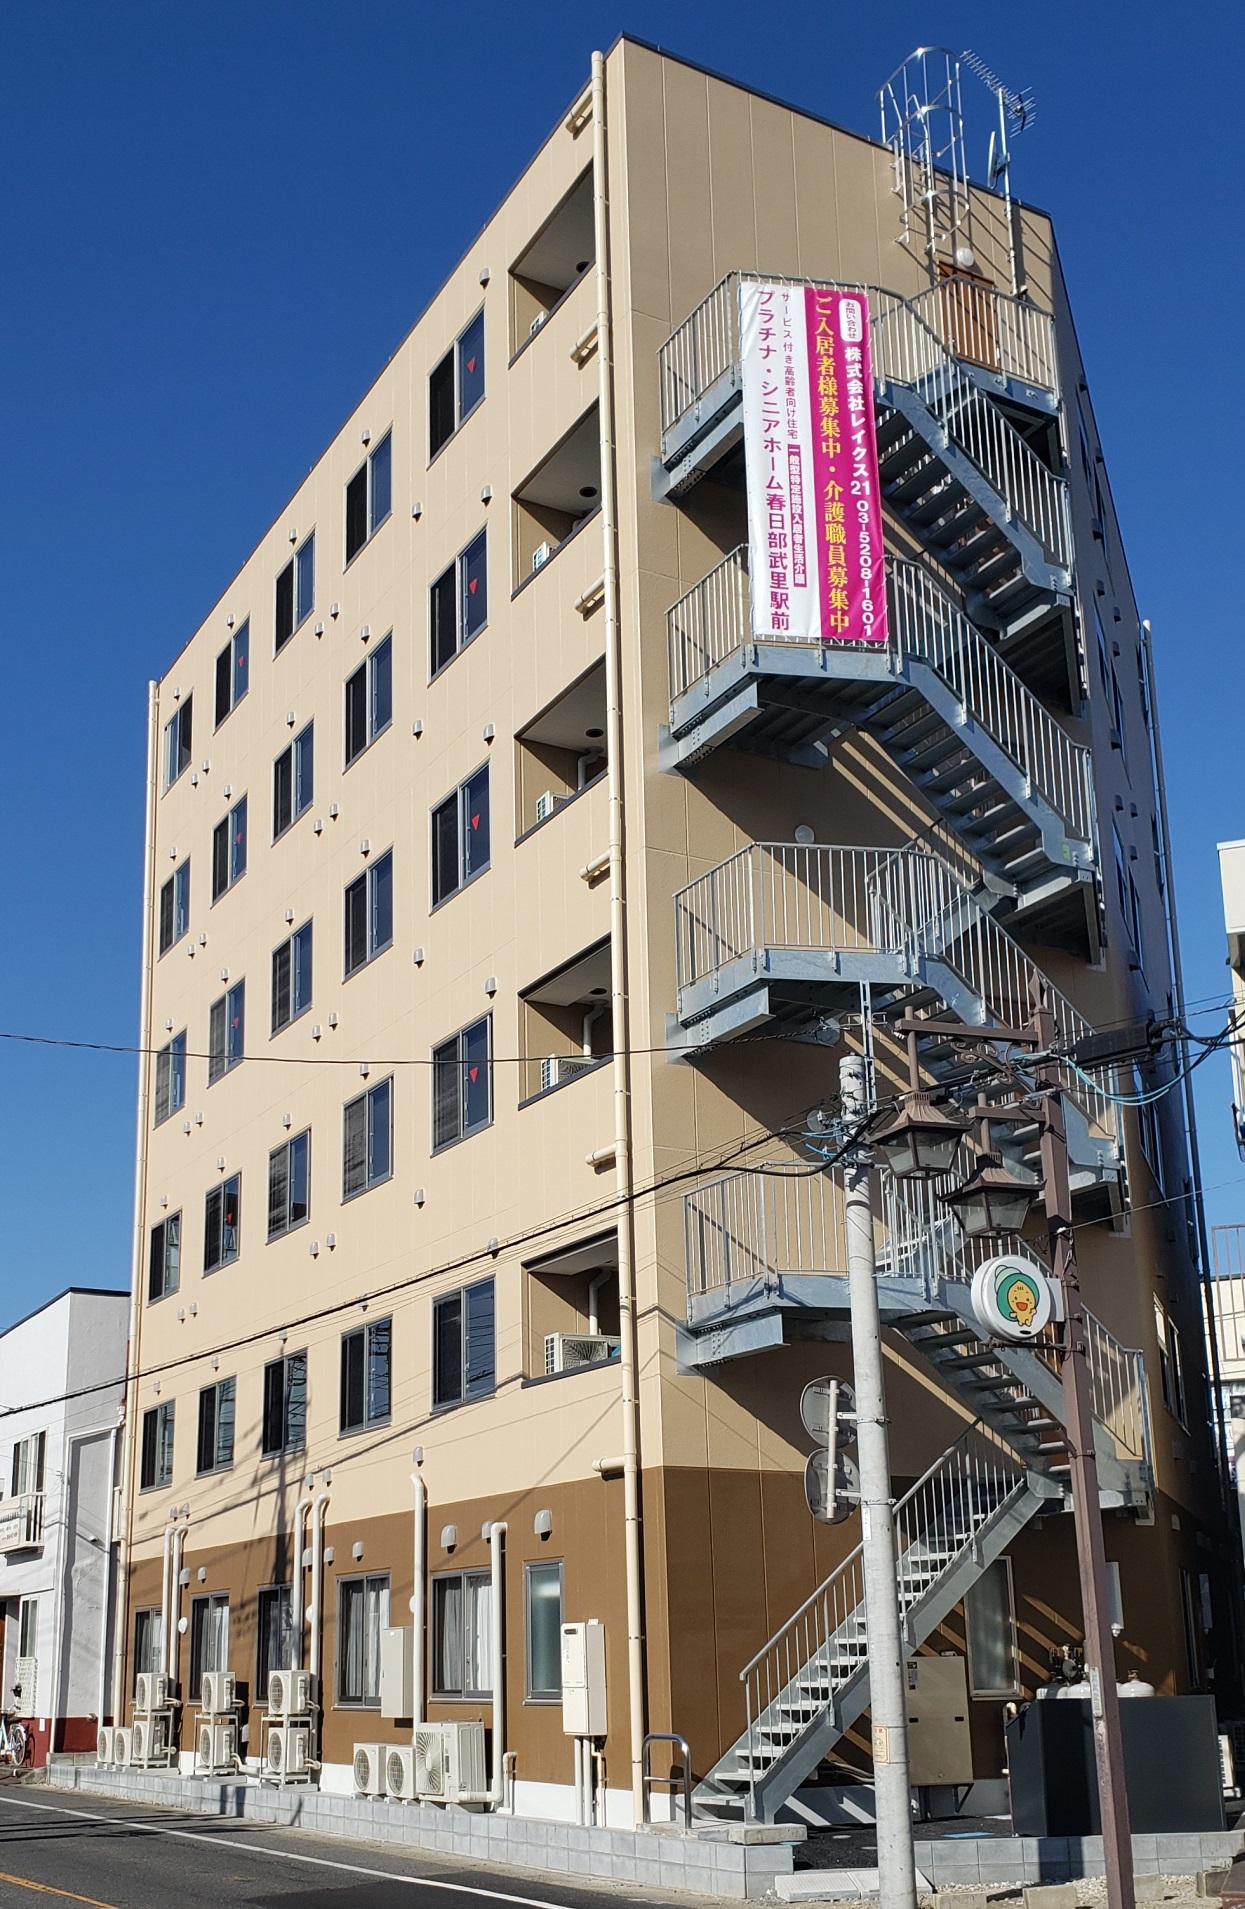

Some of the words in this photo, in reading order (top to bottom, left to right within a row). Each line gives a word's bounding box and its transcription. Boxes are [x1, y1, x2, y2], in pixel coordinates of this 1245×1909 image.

[781, 293, 798, 440] サービス付き高齢者向け住宅
[845, 301, 857, 339] お問い合わせ
[757, 290, 790, 631] プラチナ・シニアホーム春日部武里駅前
[815, 296, 849, 633] ご入居者様募集中・介護職員募集中
[857, 500, 874, 636] 03-5208-1601
